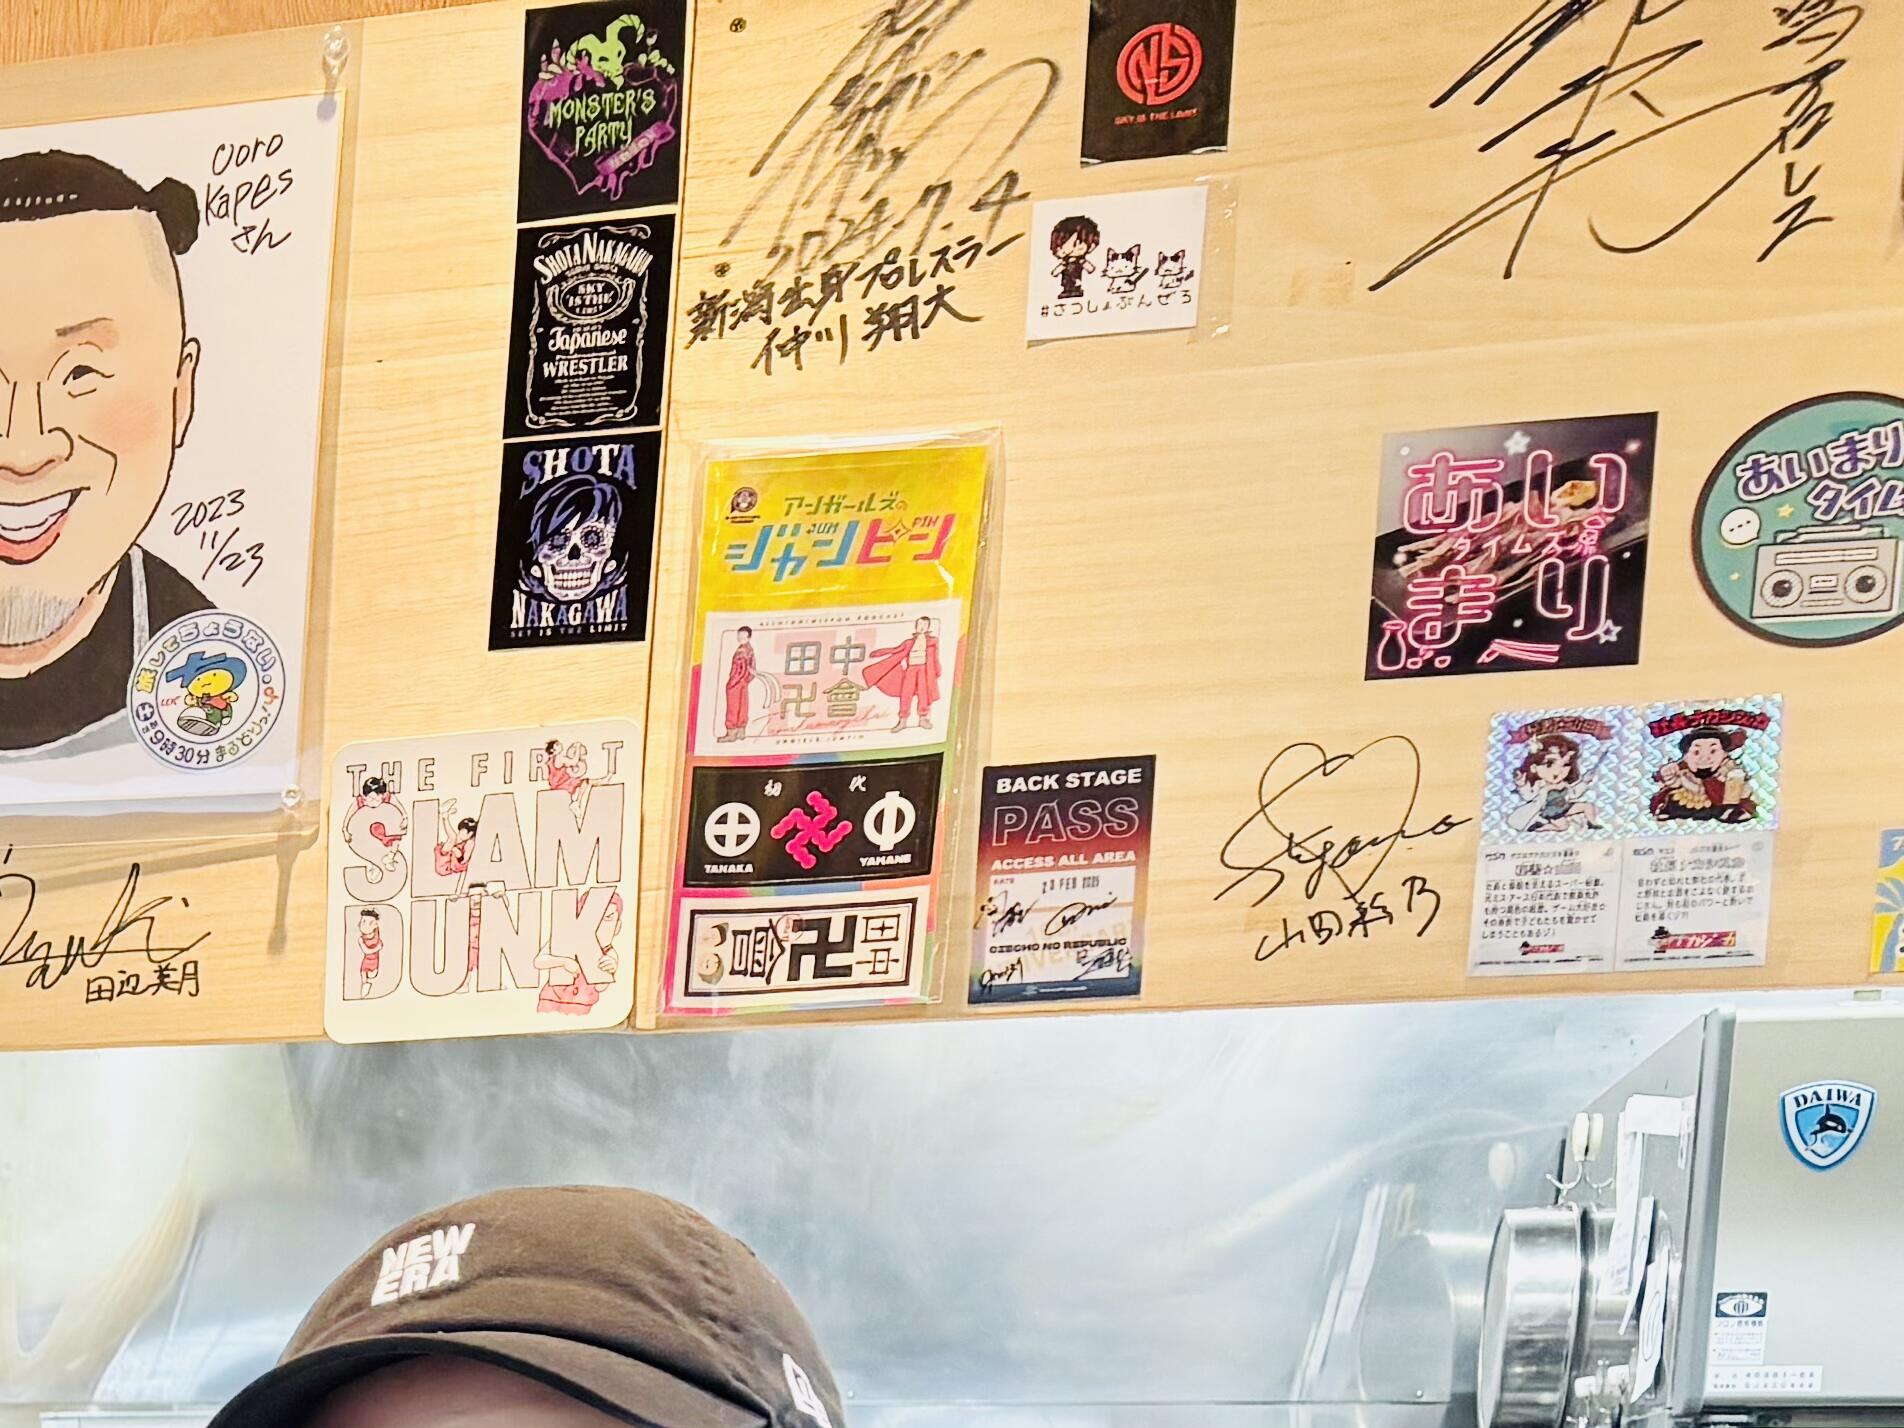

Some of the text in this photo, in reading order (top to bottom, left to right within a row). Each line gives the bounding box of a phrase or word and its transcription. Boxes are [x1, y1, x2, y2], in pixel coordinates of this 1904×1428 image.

[544, 88, 656, 128] MONSTER'S
[575, 116, 632, 157] PARTY
[230, 223, 292, 256] さん
[685, 232, 1026, 349] 新潟出身プロレスラー
[548, 327, 627, 354] Japanese
[543, 355, 628, 379] WRESTLER
[521, 445, 635, 498] SHOTA
[172, 489, 246, 536] 2023
[783, 490, 908, 518] アンガールズの
[200, 528, 266, 587] 11/23
[511, 587, 628, 628] NAKAGAWA
[784, 635, 867, 677] 田中
[345, 758, 435, 798] THE
[996, 768, 1142, 793] BACK STAGE
[992, 797, 1139, 847] PASS
[342, 782, 625, 903] SLAM
[859, 854, 912, 867] YAMANE
[991, 850, 1136, 871] ACCESS ALL AREA
[704, 863, 754, 875] TANAKA
[1059, 877, 1077, 889] FEB
[342, 886, 618, 1002] DUNK
[1042, 941, 1061, 951] NO
[1063, 937, 1127, 949] REPUBLIC
[1794, 1088, 1862, 1108] DAIWA
[381, 1223, 476, 1278] NEW
[371, 1256, 463, 1306] ERA
